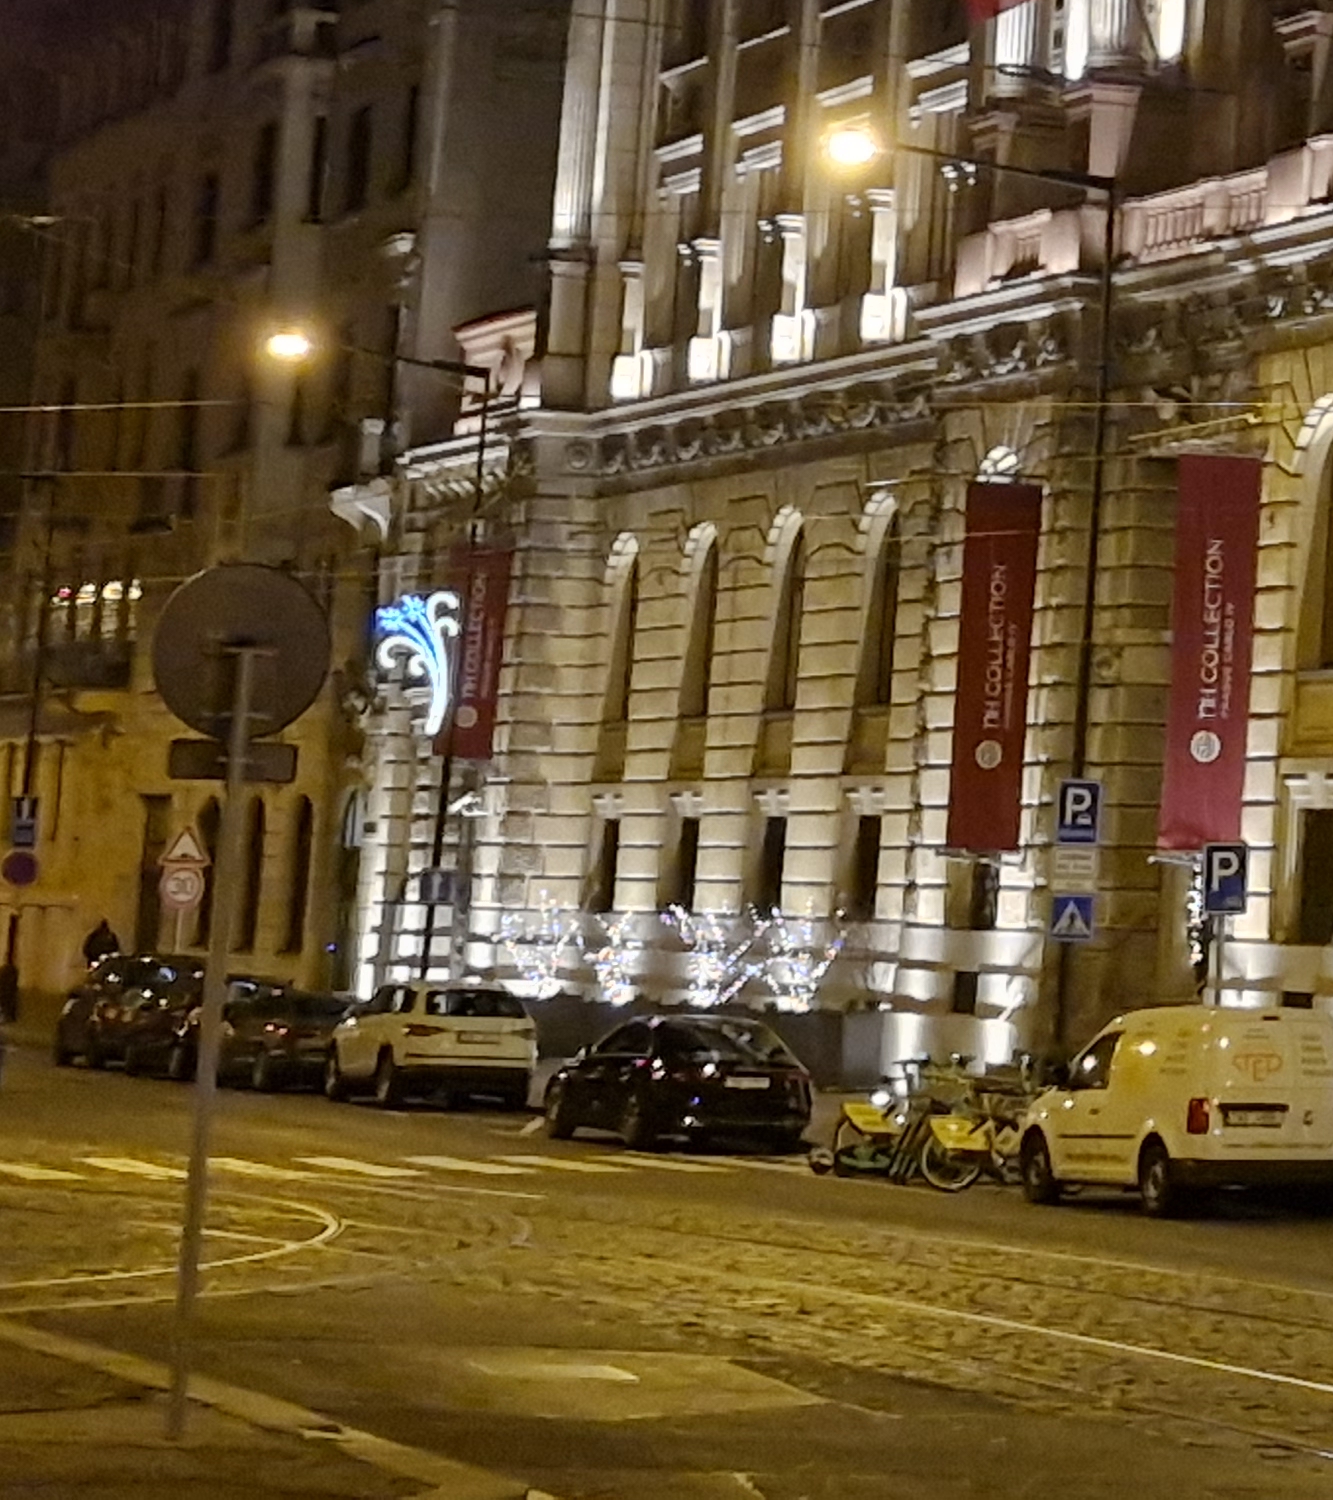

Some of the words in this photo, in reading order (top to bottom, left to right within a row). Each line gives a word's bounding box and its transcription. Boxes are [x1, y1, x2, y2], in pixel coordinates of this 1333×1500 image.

[984, 564, 1008, 697] COLLECTION
[1199, 538, 1225, 684] COLLECTION
[1064, 786, 1093, 826] P
[1211, 850, 1240, 893] P
